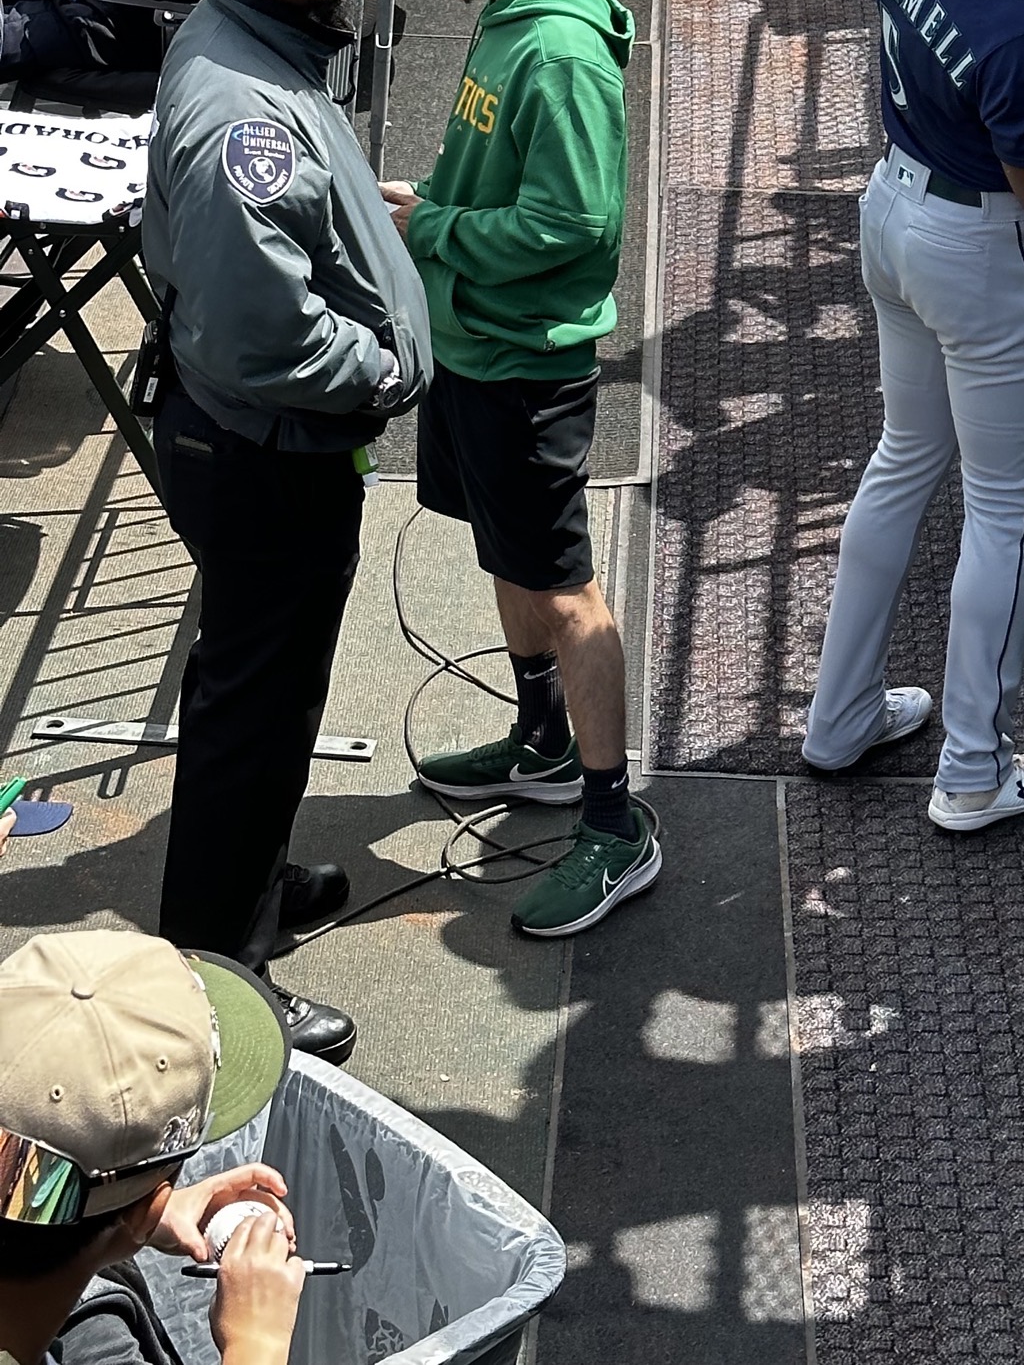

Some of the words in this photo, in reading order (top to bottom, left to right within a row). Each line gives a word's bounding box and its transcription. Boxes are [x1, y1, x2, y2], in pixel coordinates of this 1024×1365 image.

[455, 76, 498, 134] TICS
[0, 123, 149, 150] ATORAD
[243, 124, 276, 137] ALLIED
[242, 135, 291, 153] UNIVERSAL
